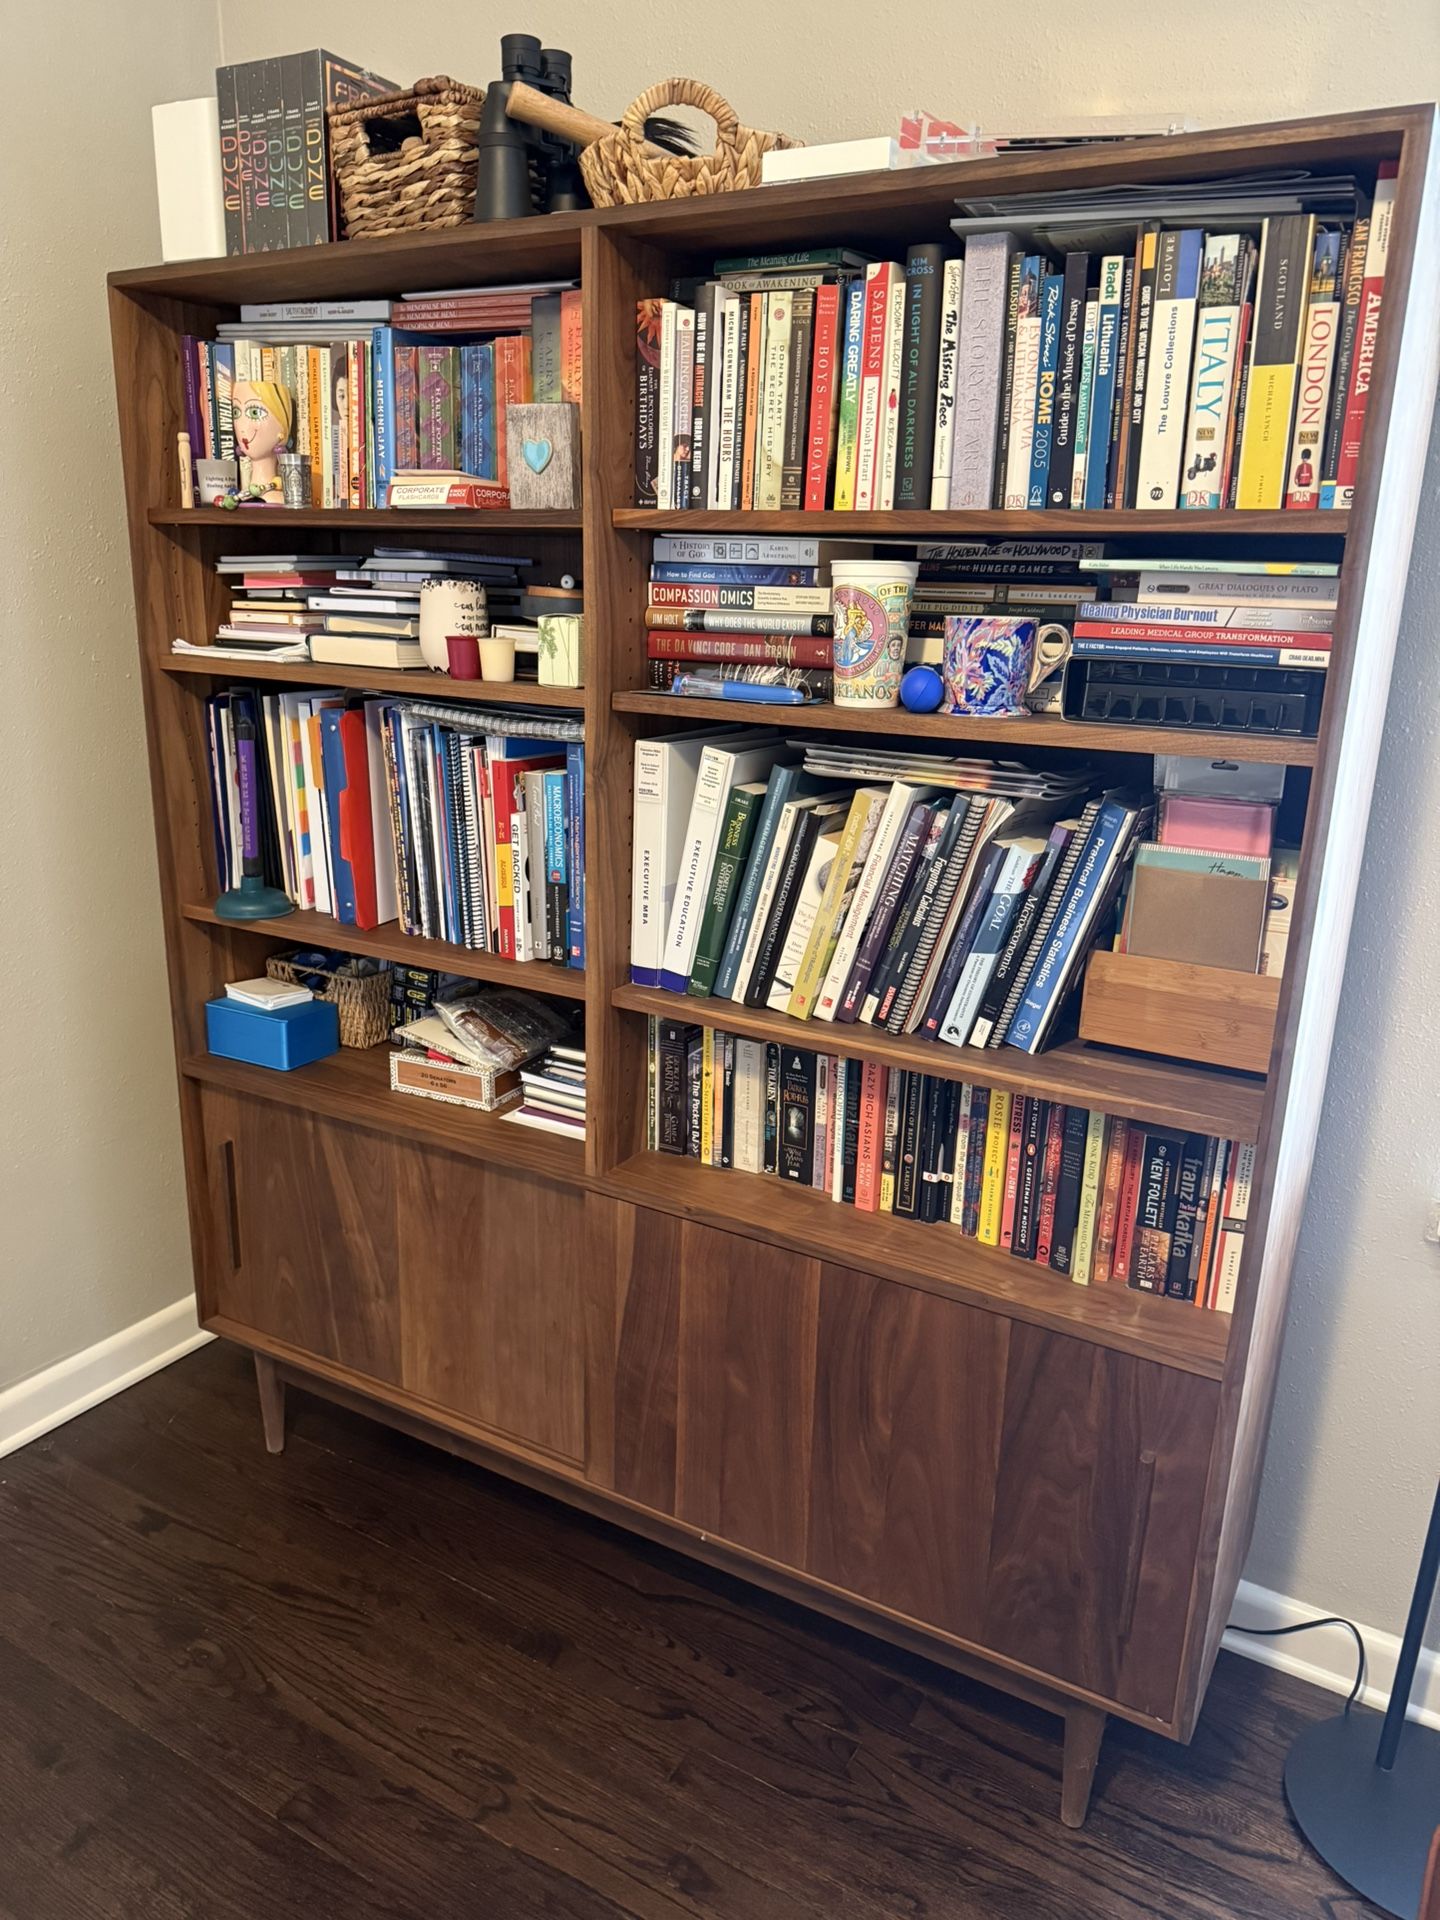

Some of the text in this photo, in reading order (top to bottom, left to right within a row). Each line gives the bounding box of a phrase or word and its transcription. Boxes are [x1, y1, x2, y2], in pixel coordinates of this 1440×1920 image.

[222, 136, 241, 211] DUNE
[240, 130, 252, 181] DUNE
[253, 140, 270, 207] DUNE
[269, 140, 285, 207] DUNE
[287, 136, 305, 209] DUNE
[306, 129, 324, 200] DUNE
[1347, 218, 1370, 305] SAN FRANCISCO
[1045, 285, 1060, 320] Rick
[1098, 261, 1120, 376] Bradt Lithuania
[1274, 259, 1289, 330] SCOTLAND
[697, 343, 706, 351] BE
[698, 312, 707, 330] HOW
[698, 332, 707, 341] TO
[1355, 291, 1382, 396] AMERICA
[696, 353, 706, 364] AN
[846, 292, 862, 403] DARING GREATLY
[963, 264, 992, 475] THE STORY OF ART
[1158, 306, 1178, 436] The Louvre Collections
[1195, 315, 1232, 420] ITALY
[1301, 309, 1334, 424] LONDON
[695, 365, 706, 408] ANTIRACIST
[726, 350, 734, 400] CUNNINGHAM
[768, 372, 776, 421] SECRET
[861, 290, 885, 482] SAPIENS Yuval Noah Harari
[905, 284, 923, 468] IN LIGHT OF ALL DARKNESS
[1012, 325, 1028, 426] & LITHUANIA
[1021, 325, 1041, 450] ESTONIA, LATVIA
[1037, 371, 1056, 425] ROME
[218, 374, 232, 433] JONATHAN
[377, 380, 385, 458] MOCKINGJAY
[639, 375, 648, 450] BIRTHDAYS
[694, 418, 703, 441] IBRAM
[724, 407, 733, 424] THE
[694, 451, 702, 472] KENDI
[722, 430, 733, 462] HOURS
[766, 427, 774, 478] HISTORY
[1034, 430, 1049, 468] 2005
[689, 550, 706, 559] GOD
[973, 565, 1017, 573] HUNGER
[1020, 566, 1054, 574] GAMES
[653, 587, 719, 604] COMPASSION
[720, 590, 753, 606] OMICS
[880, 586, 907, 596] OF THE
[1081, 604, 1218, 622] Healing Physician Burnout
[652, 613, 805, 631] JIM HOLT WHY DOES THE WORLD EXIST?
[1111, 627, 1294, 644] LEADING MEDICAL GROUP TRANSFORMATION
[656, 639, 797, 660] THE DA VINCI CODE DAN BROWN
[553, 785, 563, 868] MACROECONOMICS
[732, 812, 747, 847] BUSINESS
[512, 850, 521, 894] BACKED
[676, 840, 702, 947] EXECUTIVE EDUCATION
[885, 834, 919, 908] MATCHING
[912, 857, 948, 928] Forgotten Calculus
[758, 845, 801, 982] CORPORATE GOVERNANCE MATTERS
[988, 876, 1016, 932] THE GOAL
[1036, 837, 1105, 989] Practical Business Statistics
[997, 895, 1038, 980] Microeconomics
[407, 989, 427, 1000] G2
[409, 971, 429, 982] G2
[664, 1055, 674, 1092] MARTIN
[767, 1067, 777, 1100] TOLKIEN
[692, 1080, 701, 1142] The Pocket DJ
[863, 1063, 877, 1160] RAZY RICH ASIANS
[887, 1110, 895, 1135] BOSNIA
[909, 1088, 917, 1116] GARDEN
[909, 1117, 915, 1126] OF
[885, 1137, 894, 1152] LIST
[991, 1095, 1005, 1164] ROSIE PROJECT
[1144, 1157, 1163, 1227] KEN FOLLETT
[1173, 1158, 1203, 1258] franz kafka
[1137, 1247, 1150, 1280] EARTH
[1146, 1235, 1160, 1280] PILLARS
